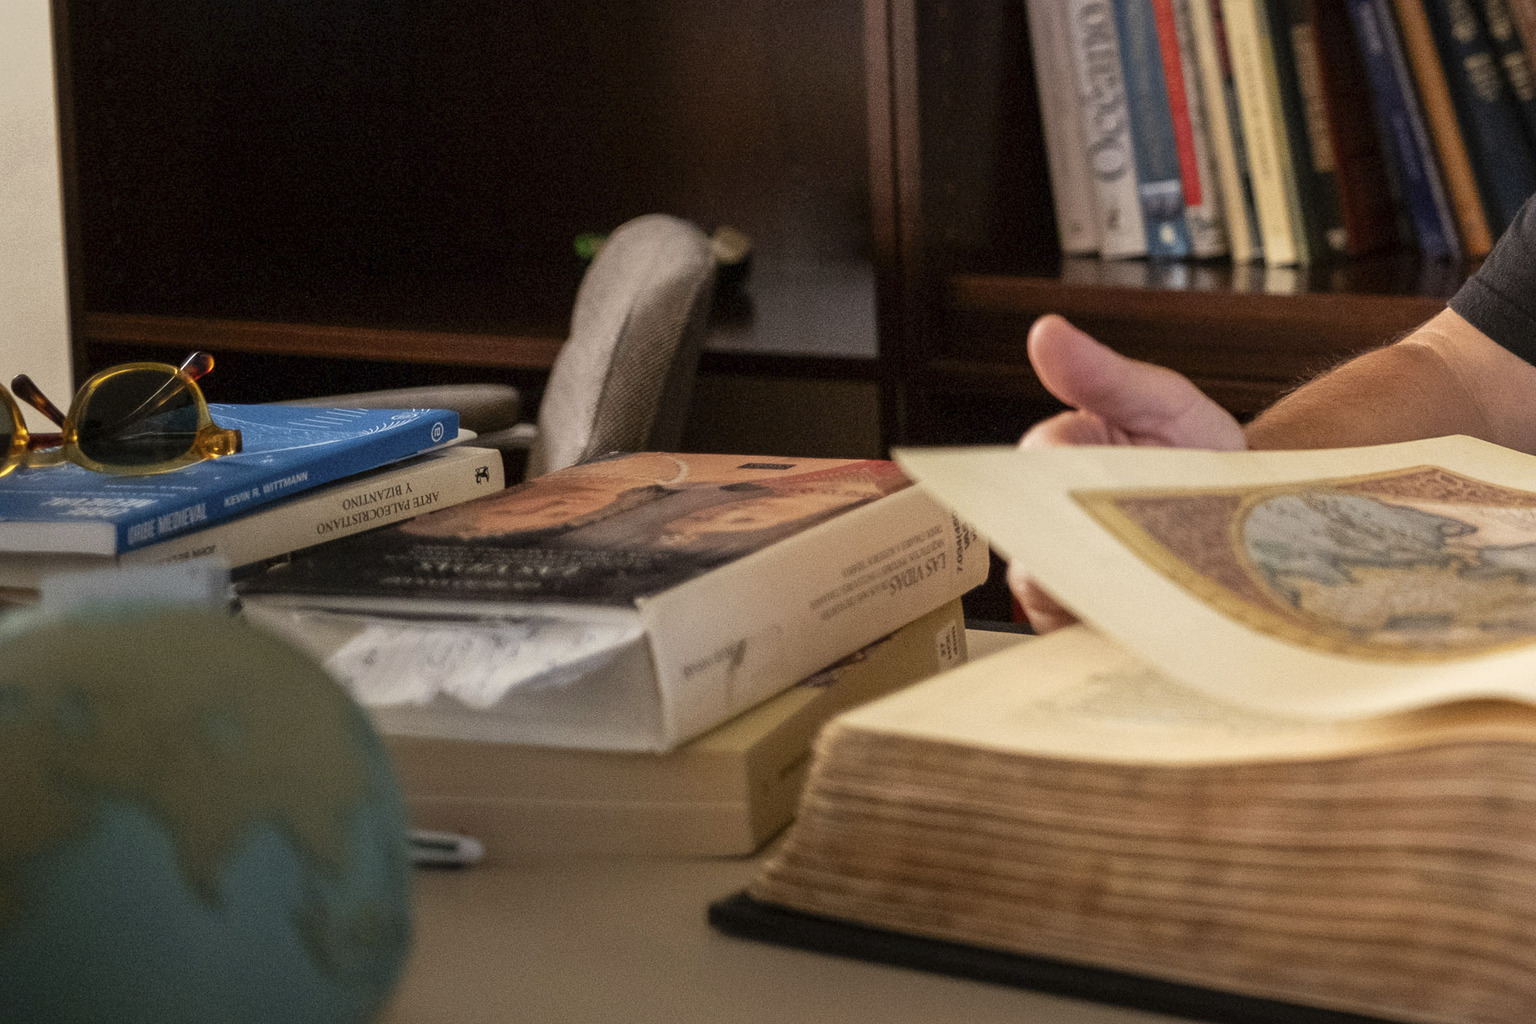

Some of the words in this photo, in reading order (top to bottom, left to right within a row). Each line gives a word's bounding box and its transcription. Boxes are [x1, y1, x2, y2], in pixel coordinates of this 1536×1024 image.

[224, 490, 251, 508] KEVIN
[252, 486, 263, 499] R.
[262, 471, 309, 494] WITTMANN
[342, 486, 403, 511] BIZANTINO
[405, 482, 414, 493] Y
[413, 491, 440, 508] ARTE
[316, 499, 411, 535] PALEOCRISTIANO
[925, 551, 947, 578] LAS
[889, 564, 925, 595] VIDAS
